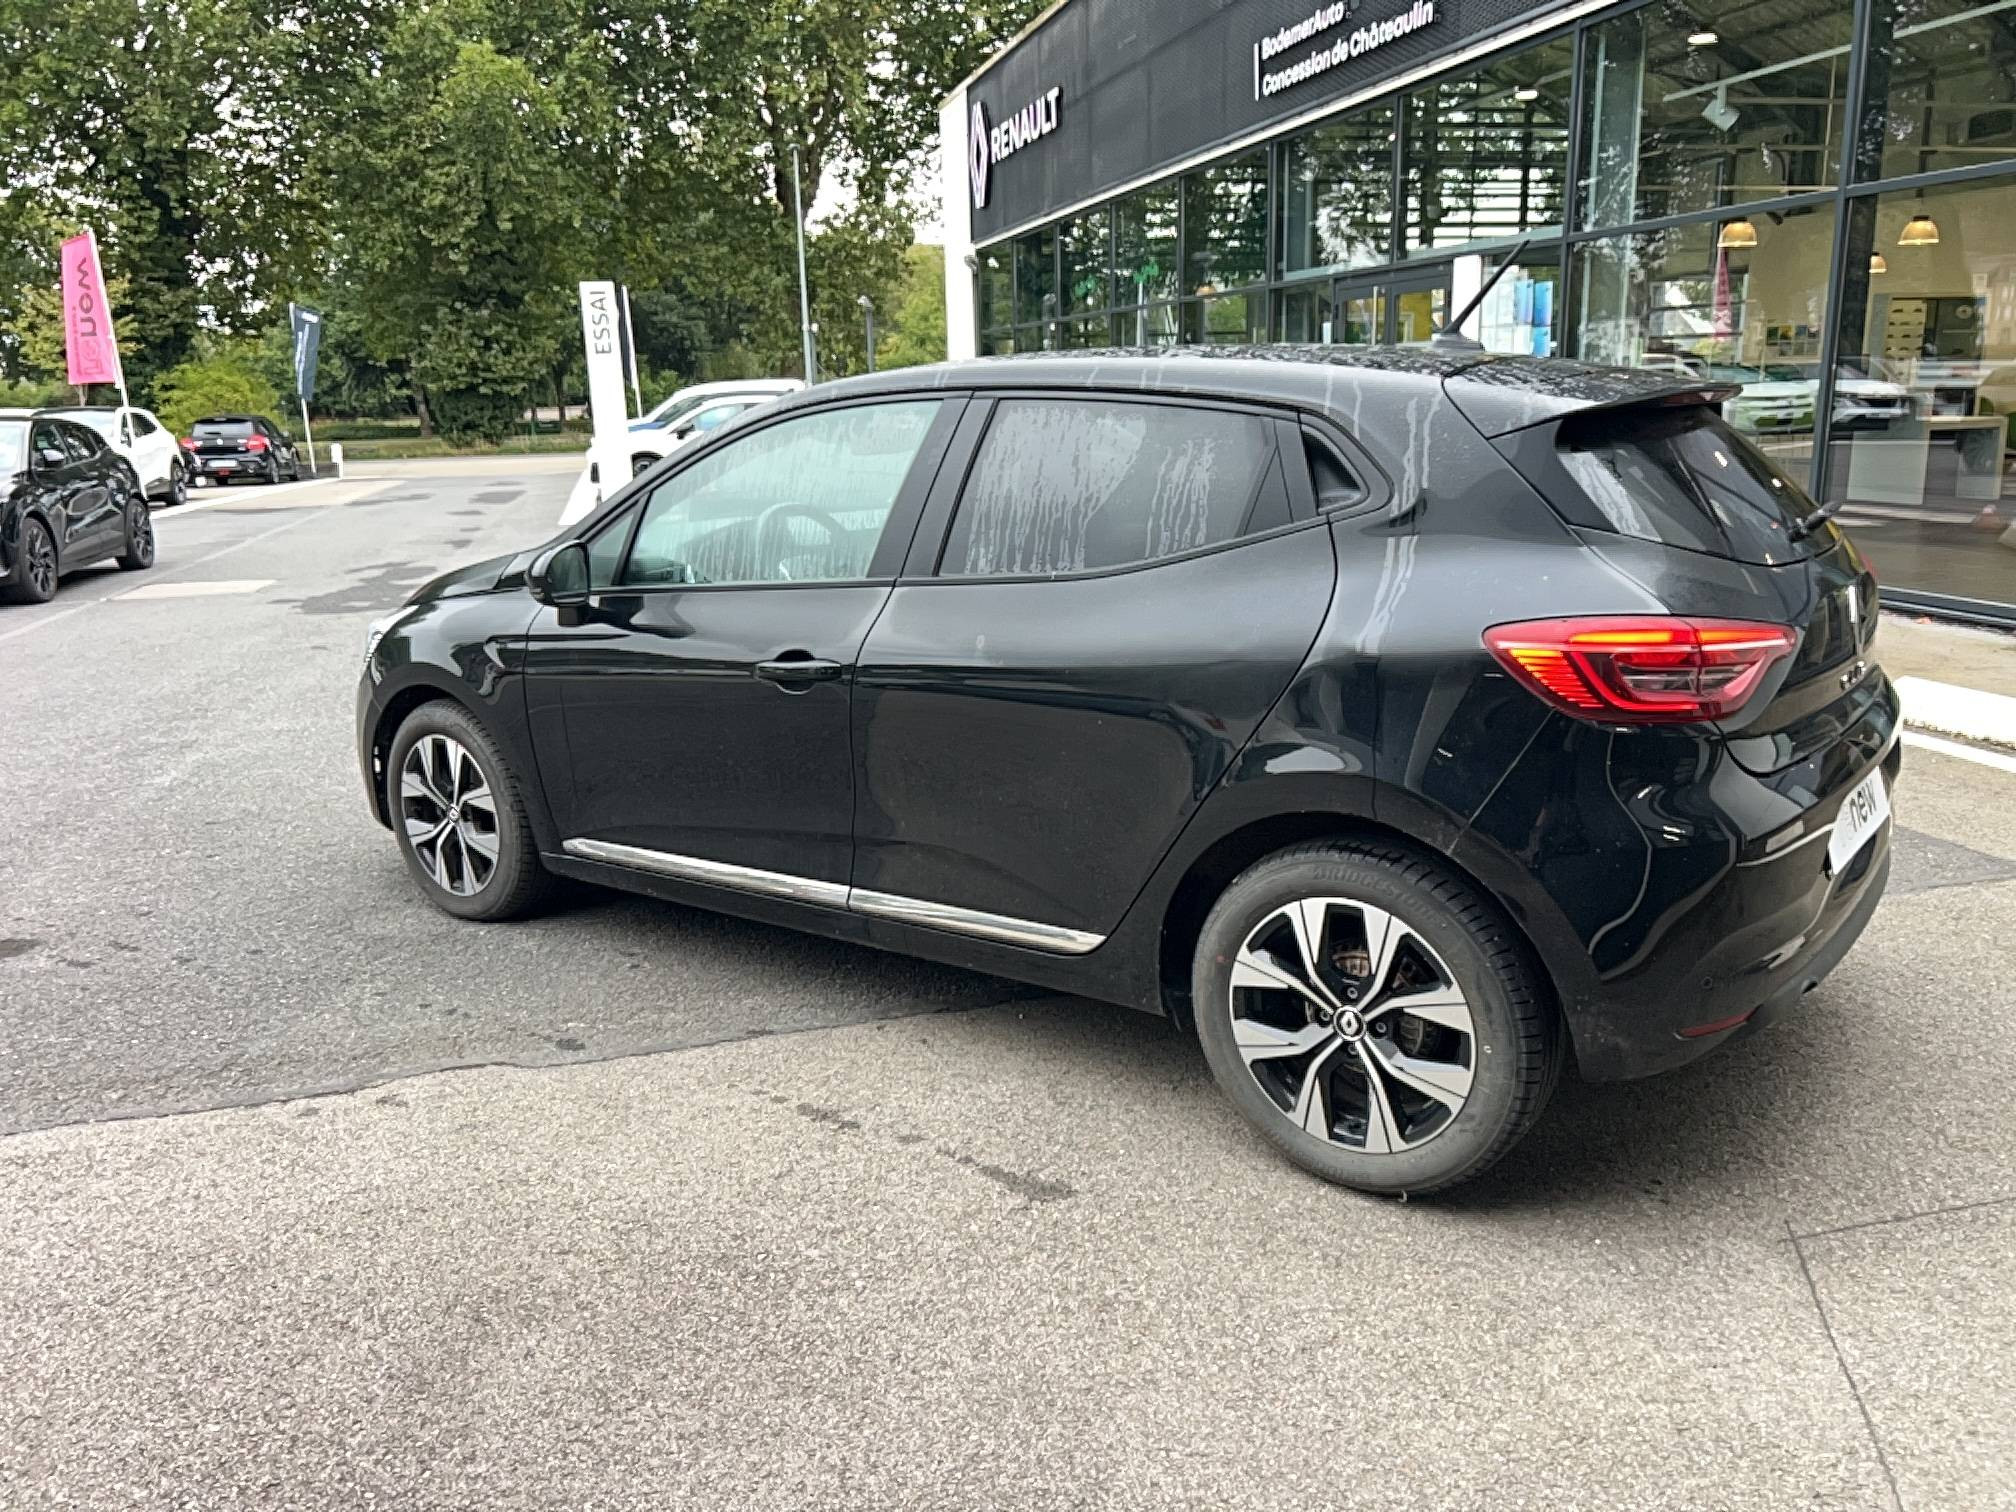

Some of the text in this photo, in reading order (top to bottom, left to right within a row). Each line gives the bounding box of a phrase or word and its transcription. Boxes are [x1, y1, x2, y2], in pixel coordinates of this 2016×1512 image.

[1261, 1, 1344, 60] BodemerAuto
[1262, 48, 1331, 96] Concession
[1331, 38, 1349, 66] de
[991, 86, 1060, 163] RENAULT
[590, 290, 611, 354] ESSAI
